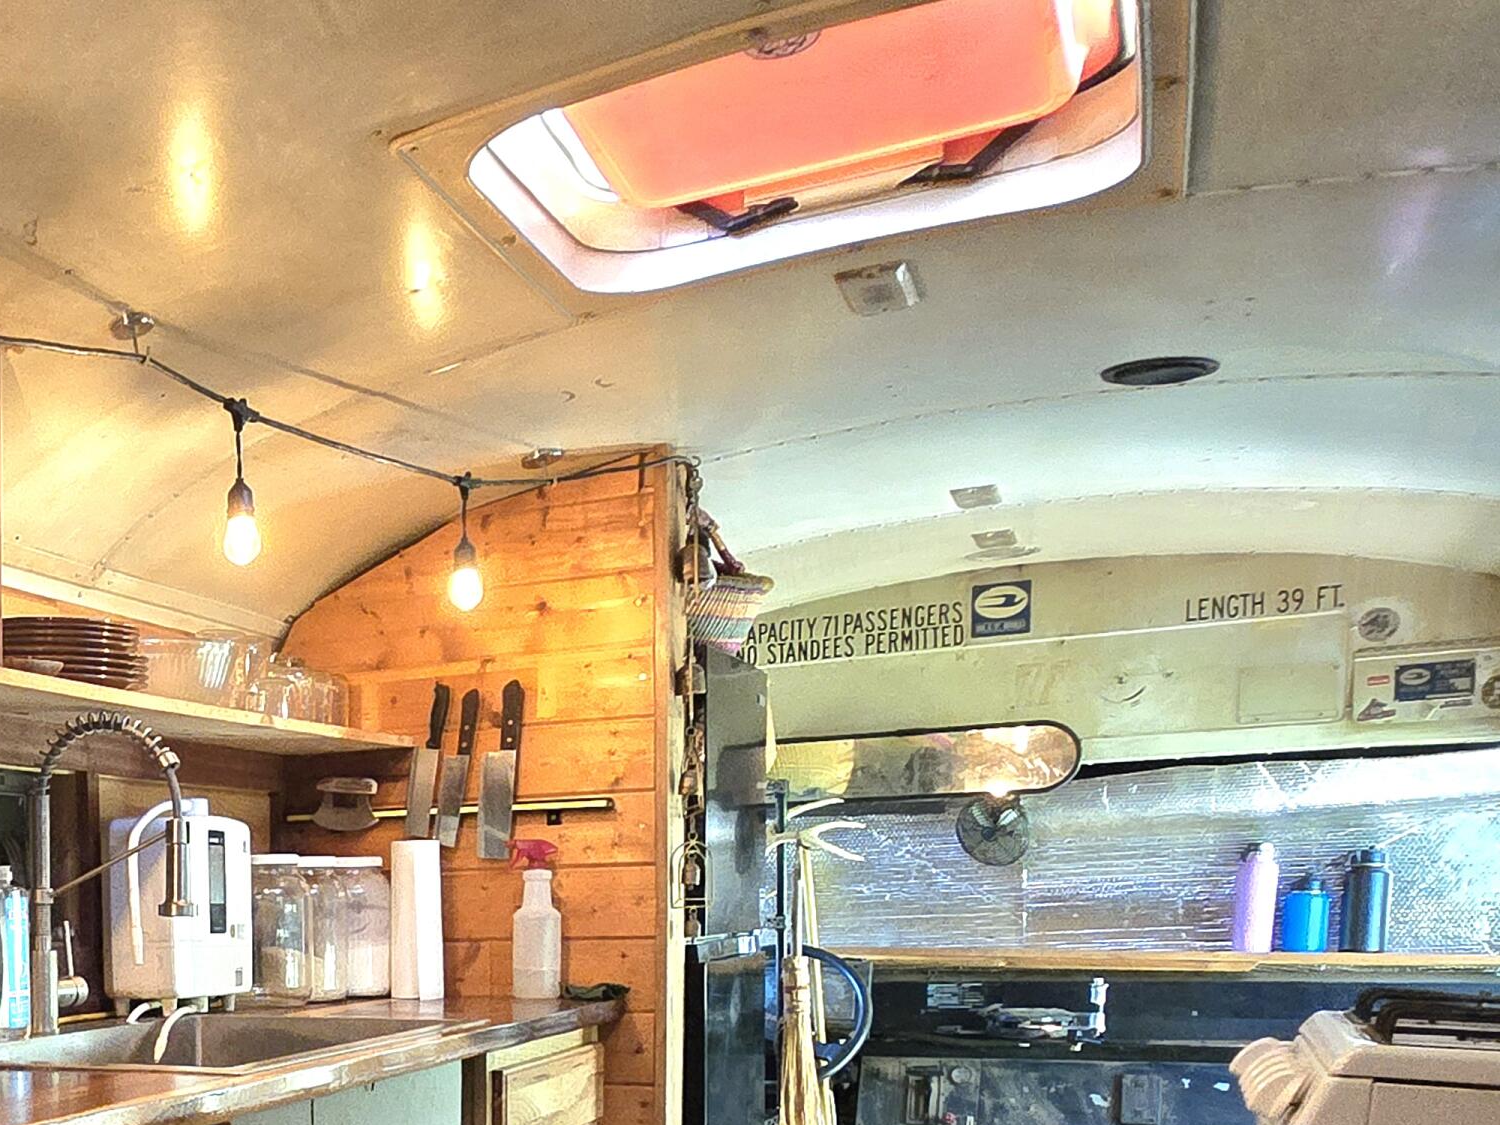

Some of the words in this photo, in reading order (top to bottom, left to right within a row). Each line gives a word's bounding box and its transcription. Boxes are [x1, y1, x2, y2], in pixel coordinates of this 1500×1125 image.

[745, 616, 818, 646] APACITY
[822, 614, 840, 638] 71
[843, 601, 963, 635] PASSENGERS
[1185, 592, 1265, 622] LENGTH
[1276, 588, 1305, 614] 39
[1316, 584, 1346, 611] FT.
[766, 635, 855, 665] STANDEES
[865, 624, 964, 656] PERMITTED
